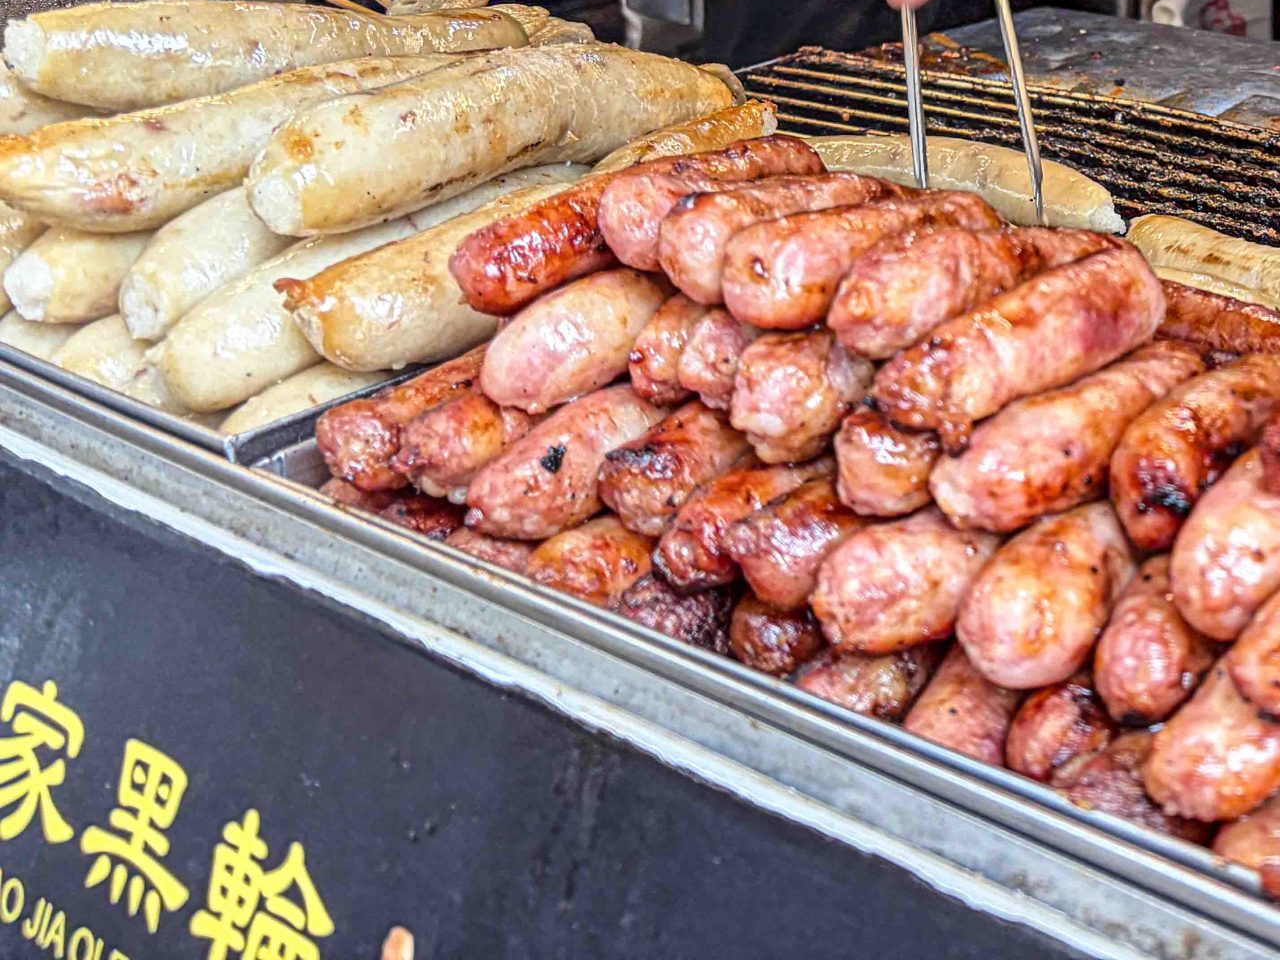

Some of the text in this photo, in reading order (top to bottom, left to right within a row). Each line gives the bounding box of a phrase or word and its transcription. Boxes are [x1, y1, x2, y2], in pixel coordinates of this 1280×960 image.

[0, 680, 335, 960] 家黑輪
[22, 897, 66, 959] JIA
